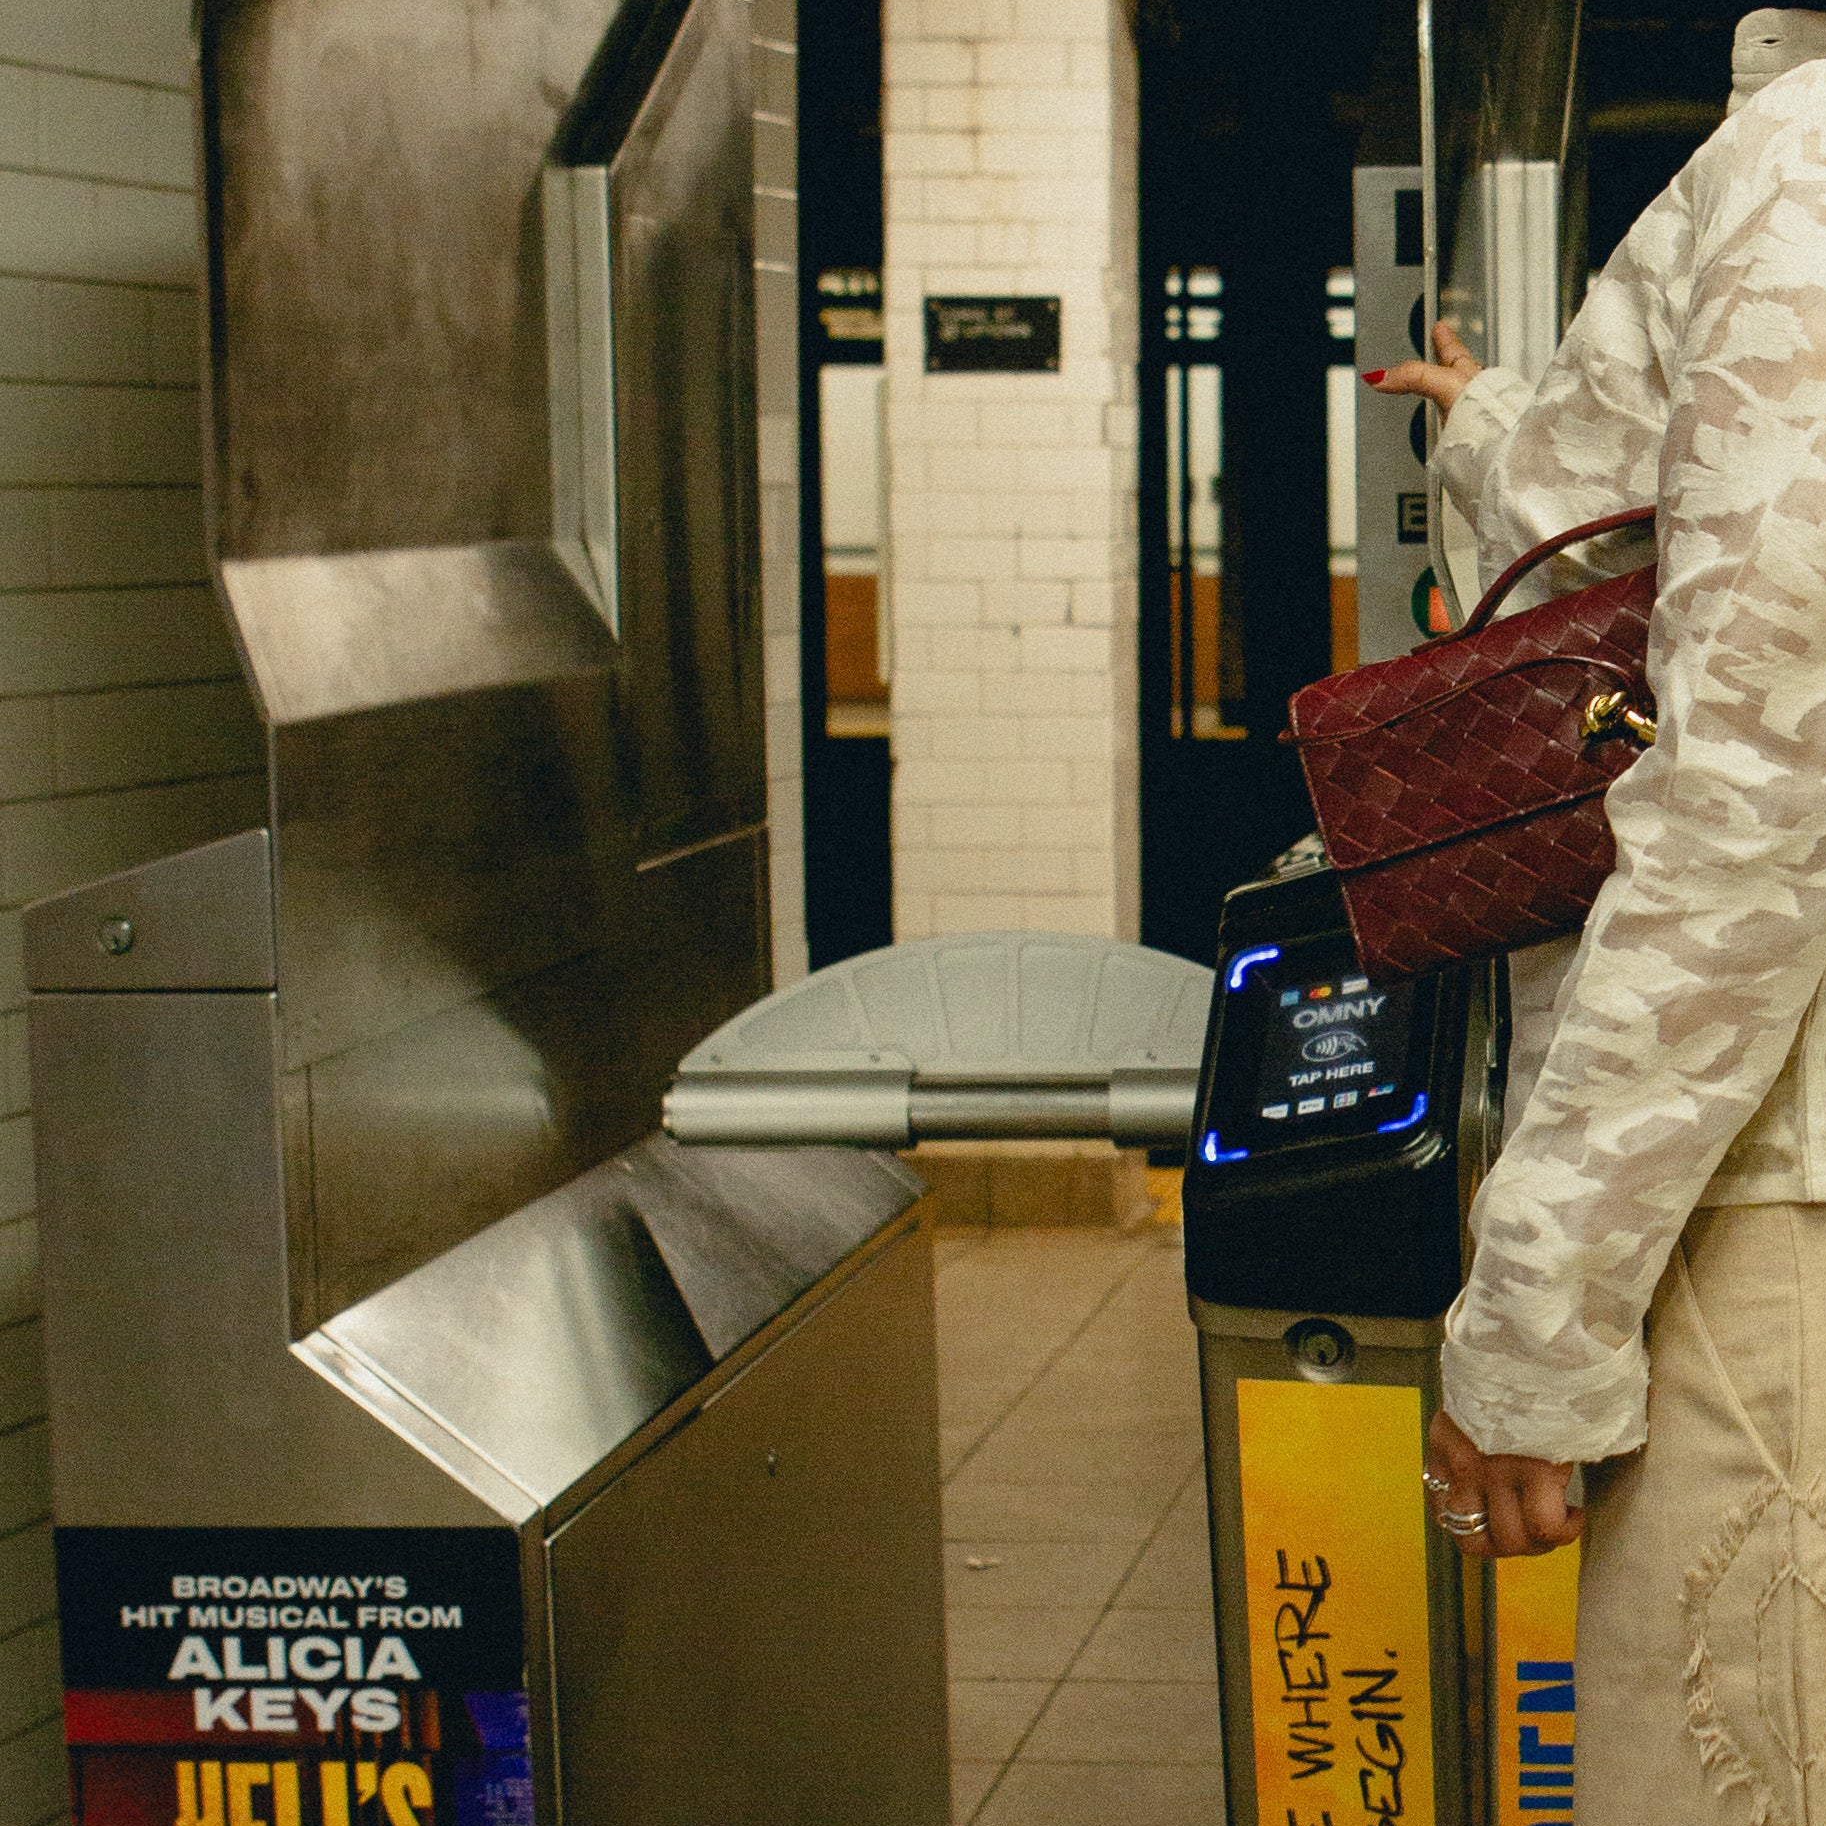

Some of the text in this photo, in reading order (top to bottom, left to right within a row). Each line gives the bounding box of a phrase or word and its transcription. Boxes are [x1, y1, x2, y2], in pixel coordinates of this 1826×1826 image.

[1293, 995, 1386, 1029] OMNY
[1289, 1061, 1375, 1087] TAP HERE
[171, 1575, 409, 1600] BROADWAY'S
[121, 1605, 463, 1629] HIT MUSICAL FROM
[168, 1635, 422, 1681] ALICIA
[1275, 1550, 1335, 1780] WHERE
[193, 1687, 402, 1733] KEYS
